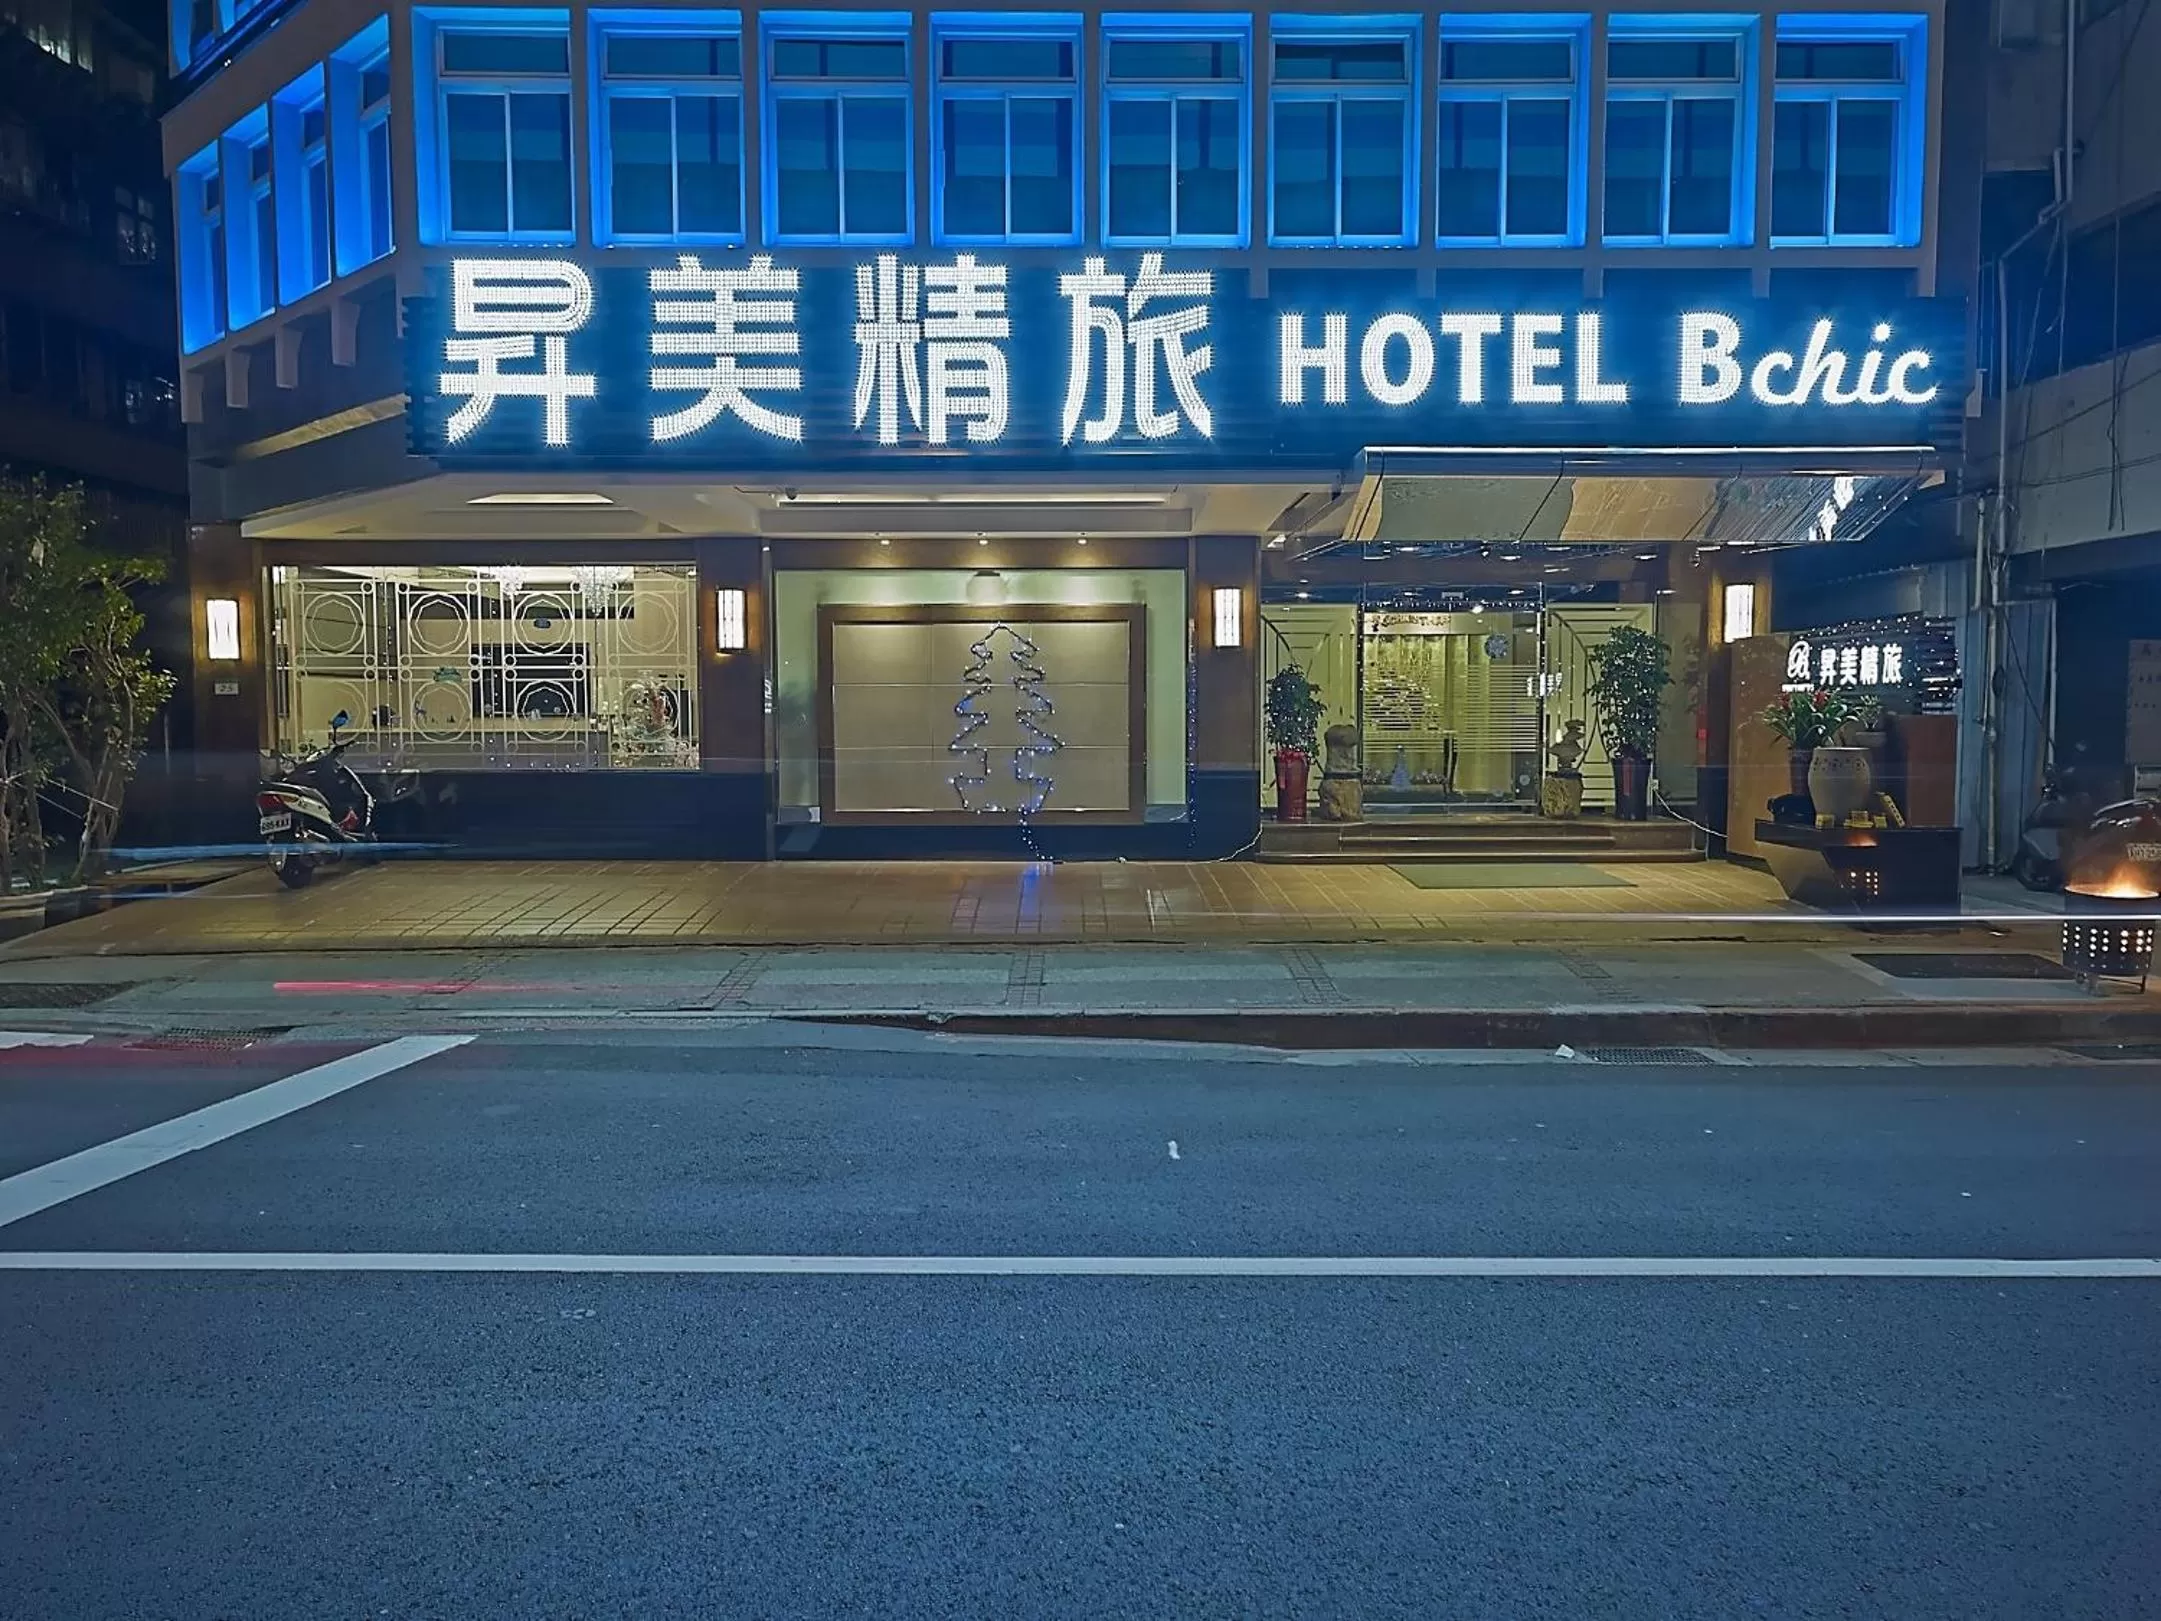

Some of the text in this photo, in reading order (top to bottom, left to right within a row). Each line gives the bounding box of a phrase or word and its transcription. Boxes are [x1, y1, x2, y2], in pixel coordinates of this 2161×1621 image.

[439, 252, 1214, 446] 昇美精旅
[1279, 312, 1938, 406] HOTEL Bchic
[1819, 643, 1903, 685] 昇美精旅
